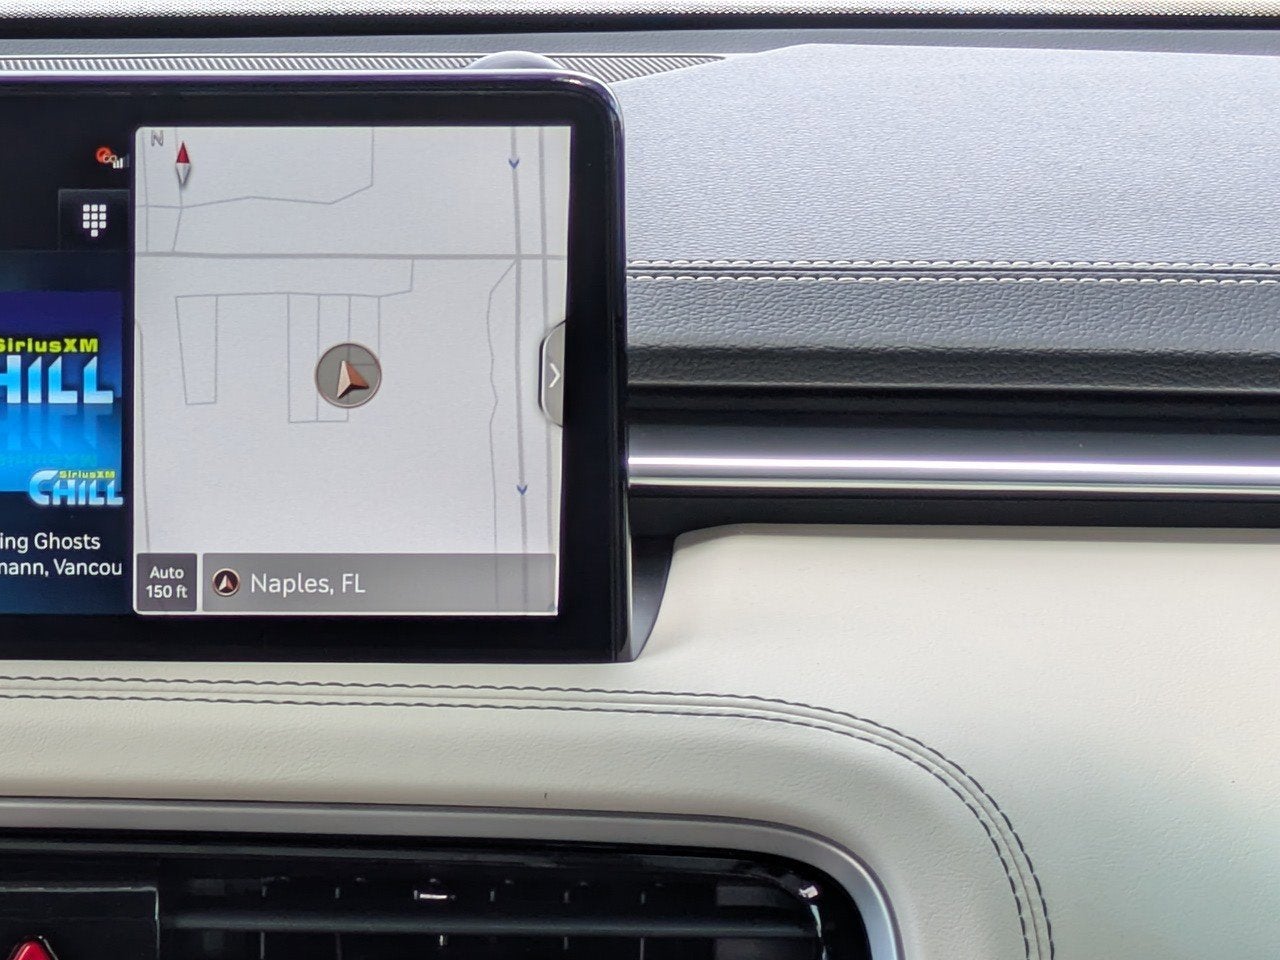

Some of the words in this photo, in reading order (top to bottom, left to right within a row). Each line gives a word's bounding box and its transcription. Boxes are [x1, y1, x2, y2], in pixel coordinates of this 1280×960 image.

[150, 129, 165, 147] N
[33, 531, 101, 550] Ghosts
[149, 565, 185, 580] Auto
[145, 584, 173, 599] 150
[175, 584, 188, 599] ft
[251, 573, 334, 598] Naples,
[342, 573, 366, 594] FL
